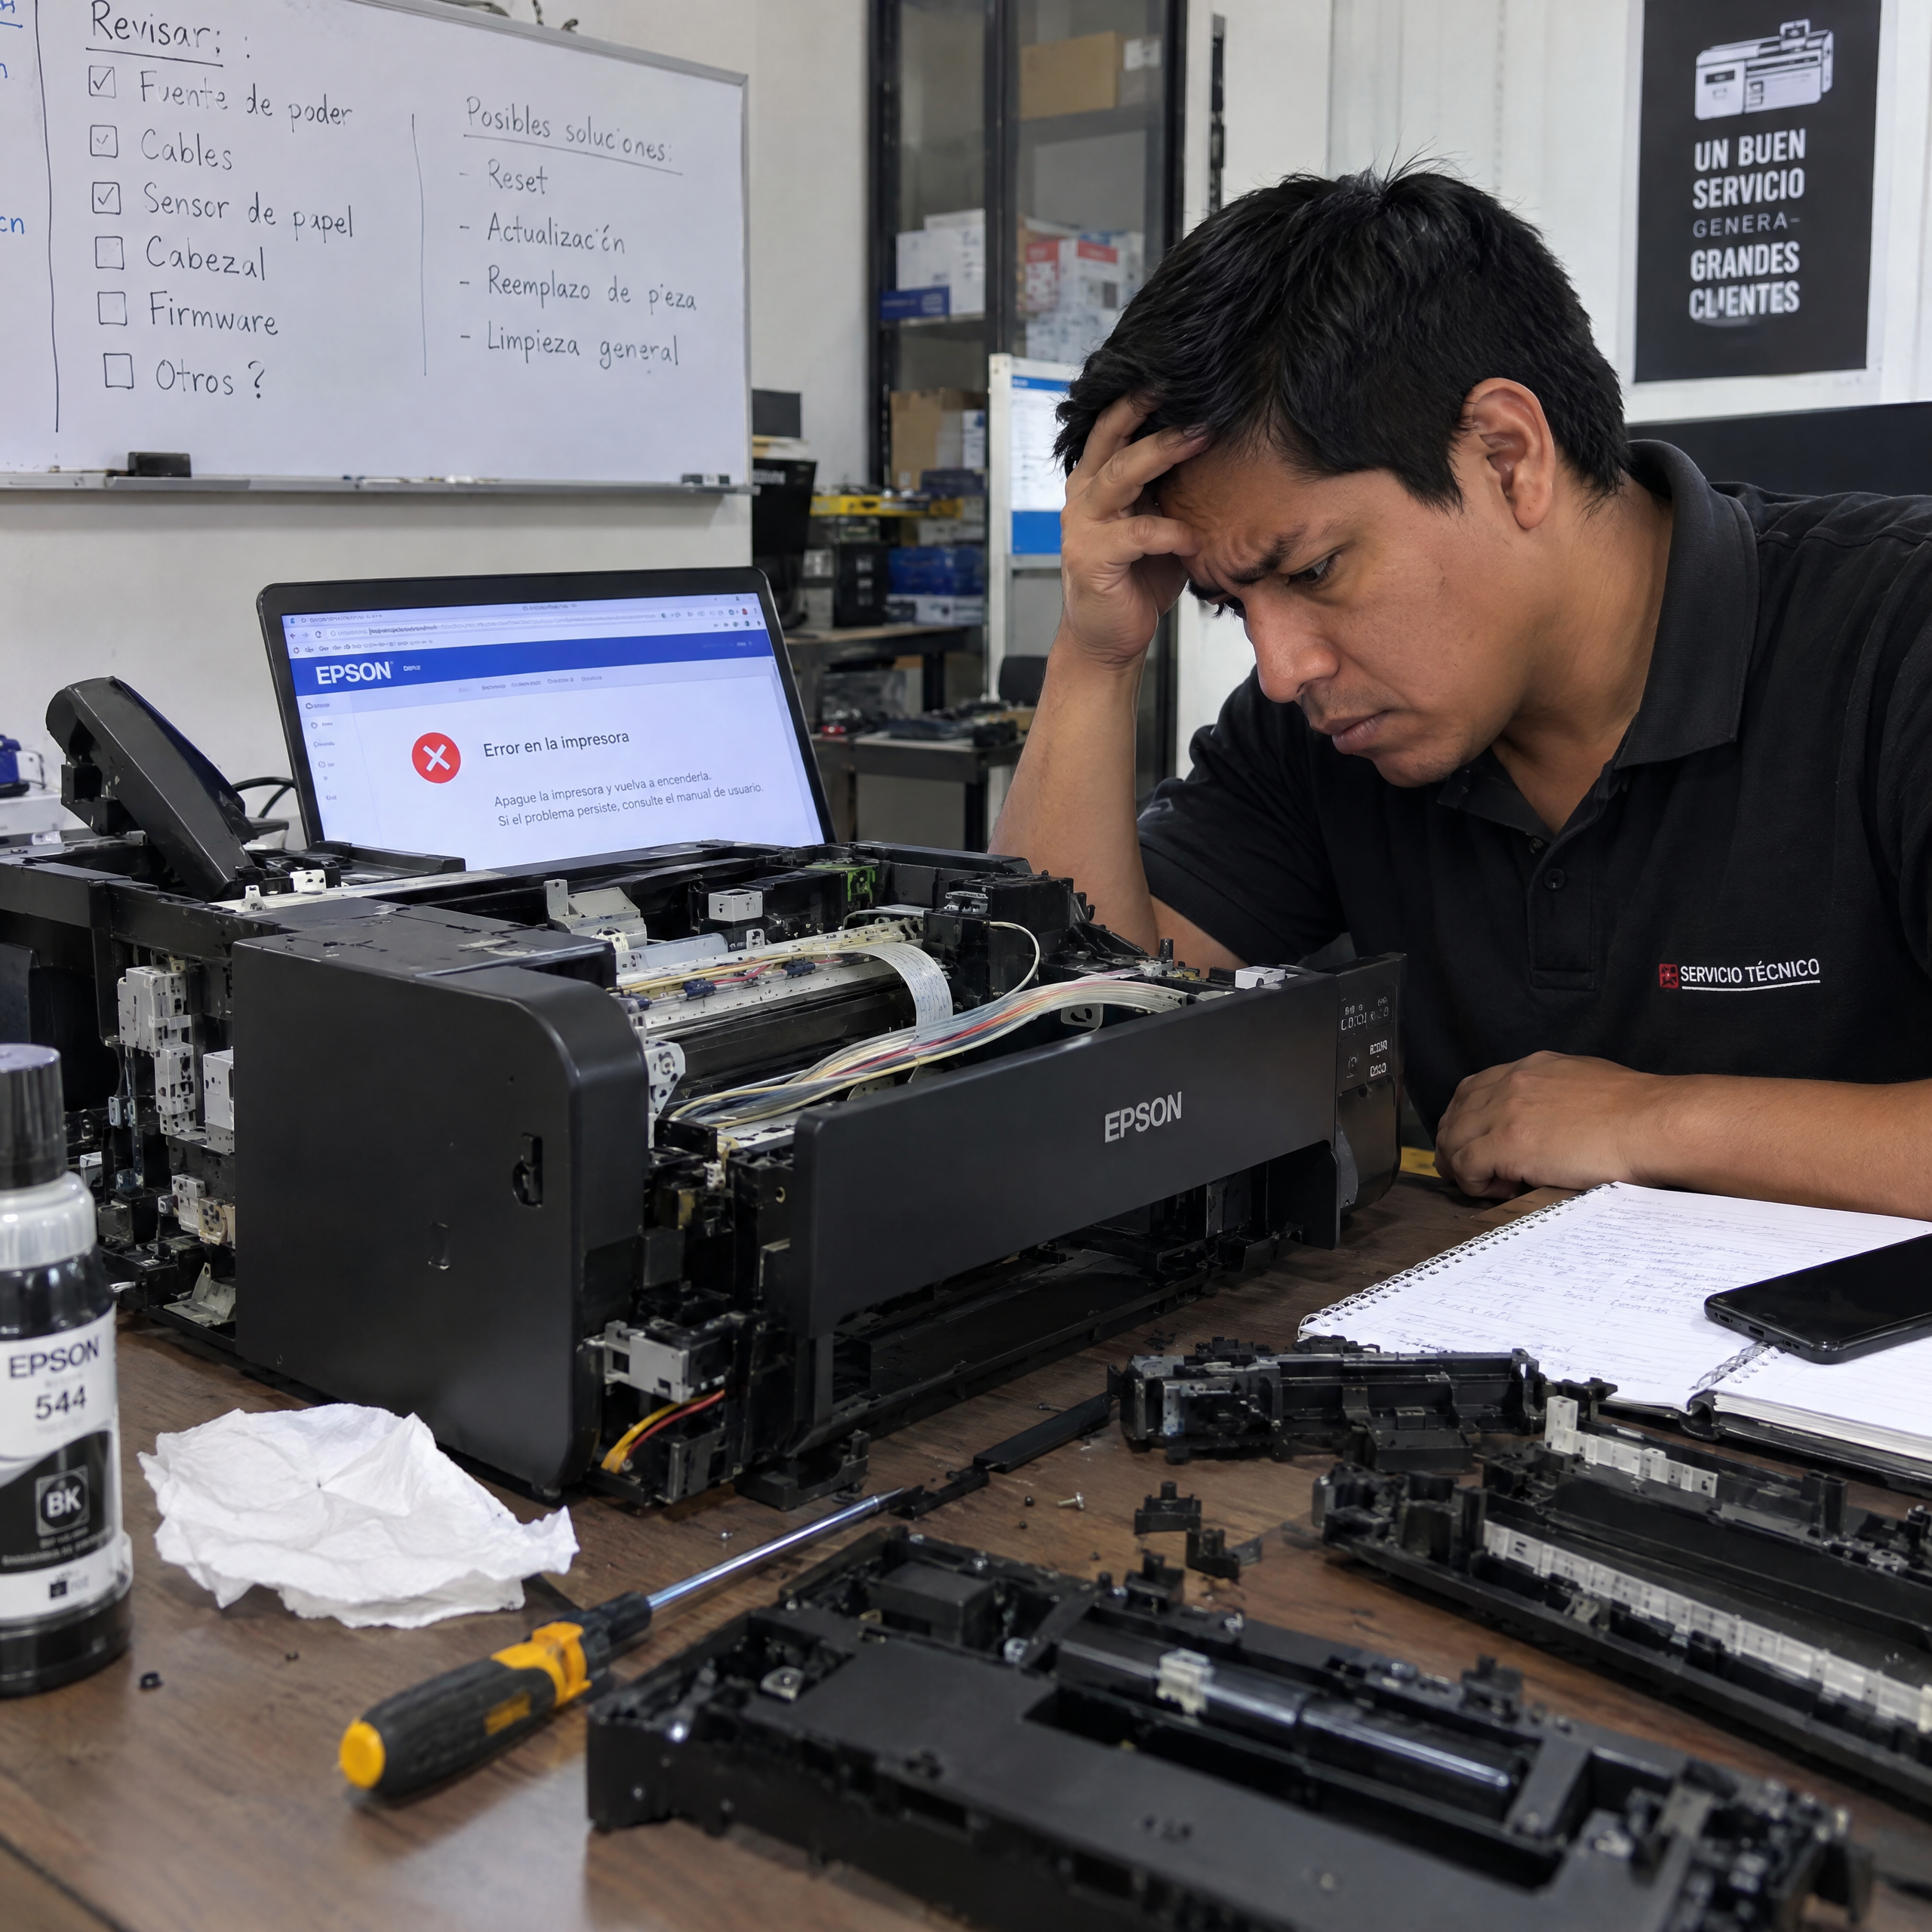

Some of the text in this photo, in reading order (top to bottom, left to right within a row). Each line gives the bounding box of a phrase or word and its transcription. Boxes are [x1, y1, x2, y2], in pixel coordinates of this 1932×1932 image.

[91, 0, 220, 56] Revisar:
[140, 70, 353, 133] Fuente de poder
[141, 128, 232, 170] Cables
[466, 96, 673, 162] Posibles soluciones:
[1694, 128, 1807, 172] UN BUEN
[488, 158, 549, 195] Reset
[1692, 168, 1805, 210] SERVICIO
[144, 182, 353, 243] Sensor de papel
[146, 235, 266, 281] Cabezal
[1690, 240, 1801, 282] GRANDES
[488, 265, 590, 309] Reemplazo
[608, 275, 632, 303] de
[649, 284, 697, 315] pieza
[1688, 279, 1801, 320] CLIENTES
[150, 291, 278, 335] Firmware
[488, 320, 580, 364] Limpieza
[599, 334, 679, 370] general
[155, 359, 234, 395] Otros
[315, 661, 392, 685] EPSON
[483, 731, 629, 757] Error en la impresora
[494, 771, 712, 809] Apague la impresora y vuelva a encenderla.
[498, 783, 764, 826] Si el problema persiste, consulte el manual de usuario.
[1680, 958, 1820, 983] SERVICIO TÉCNICO
[1104, 1091, 1182, 1143] EPSON
[9, 1336, 100, 1380] EPSON
[35, 1384, 87, 1421] 544
[46, 1484, 82, 1518] BK
